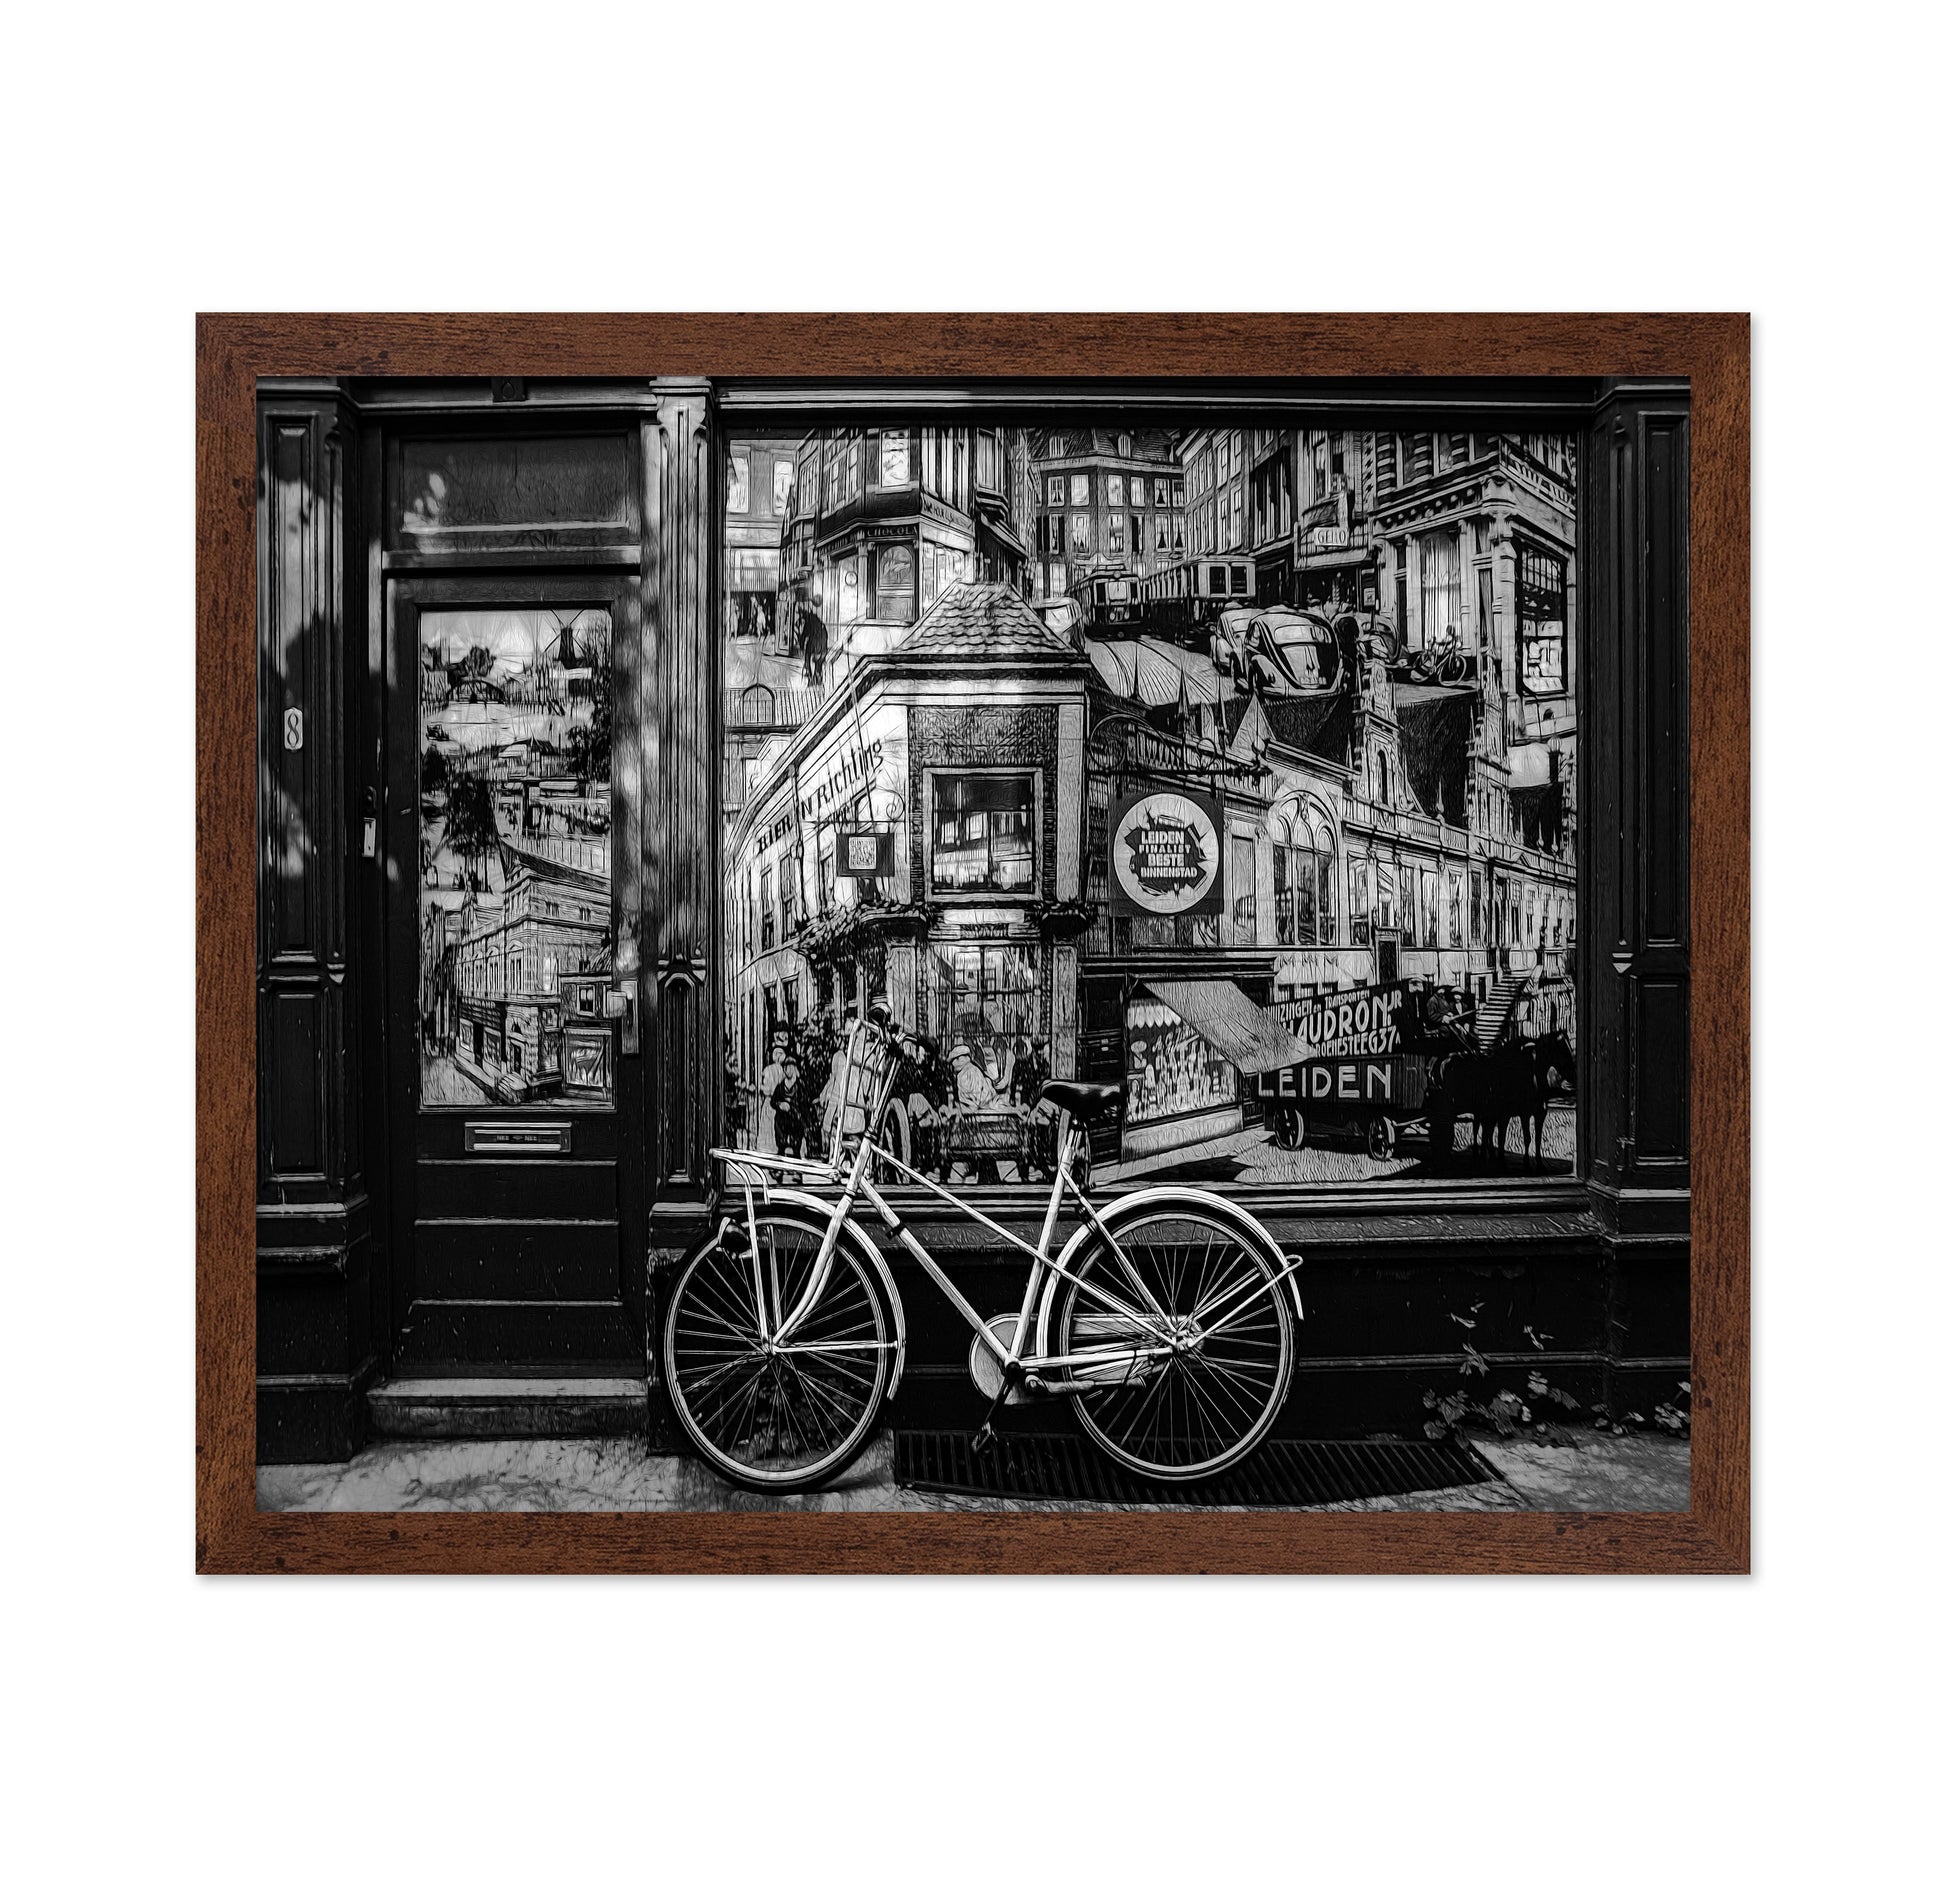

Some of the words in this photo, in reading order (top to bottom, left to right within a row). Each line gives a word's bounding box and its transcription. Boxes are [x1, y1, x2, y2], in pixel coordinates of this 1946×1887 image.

[287, 713, 300, 748] 8
[1141, 831, 1184, 844] LEIDEN
[1139, 844, 1191, 854] FINALIST
[1148, 853, 1184, 867] BESTE
[1141, 867, 1198, 878] BINNENSTAD
[1258, 1064, 1391, 1099] LEIDEN
